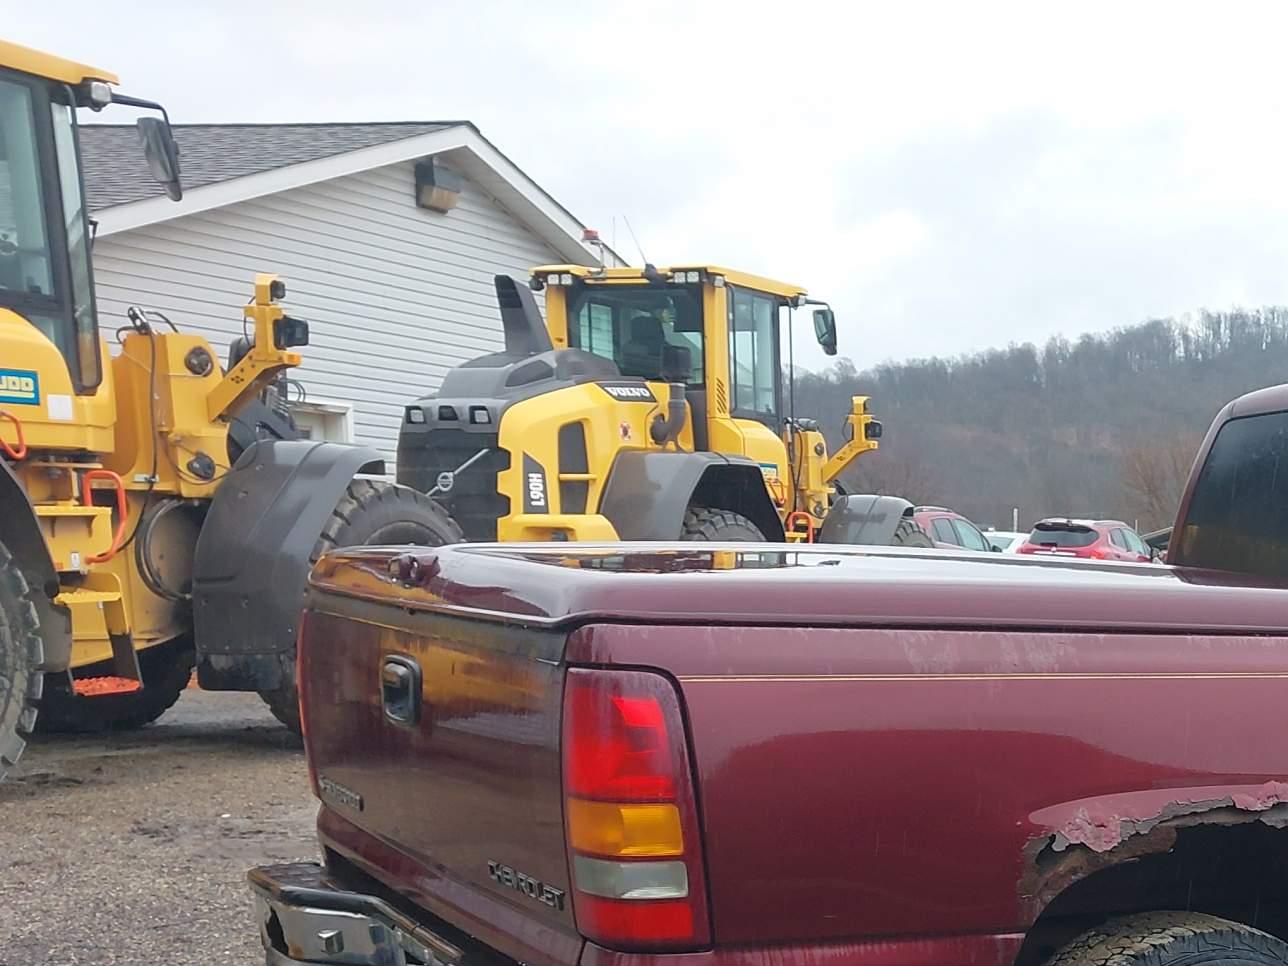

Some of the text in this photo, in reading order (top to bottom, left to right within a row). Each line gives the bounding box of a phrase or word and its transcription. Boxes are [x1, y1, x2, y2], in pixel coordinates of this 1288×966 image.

[604, 386, 651, 398] VOLVO
[528, 473, 545, 507] L90H
[487, 858, 565, 911] CHEVROLET
